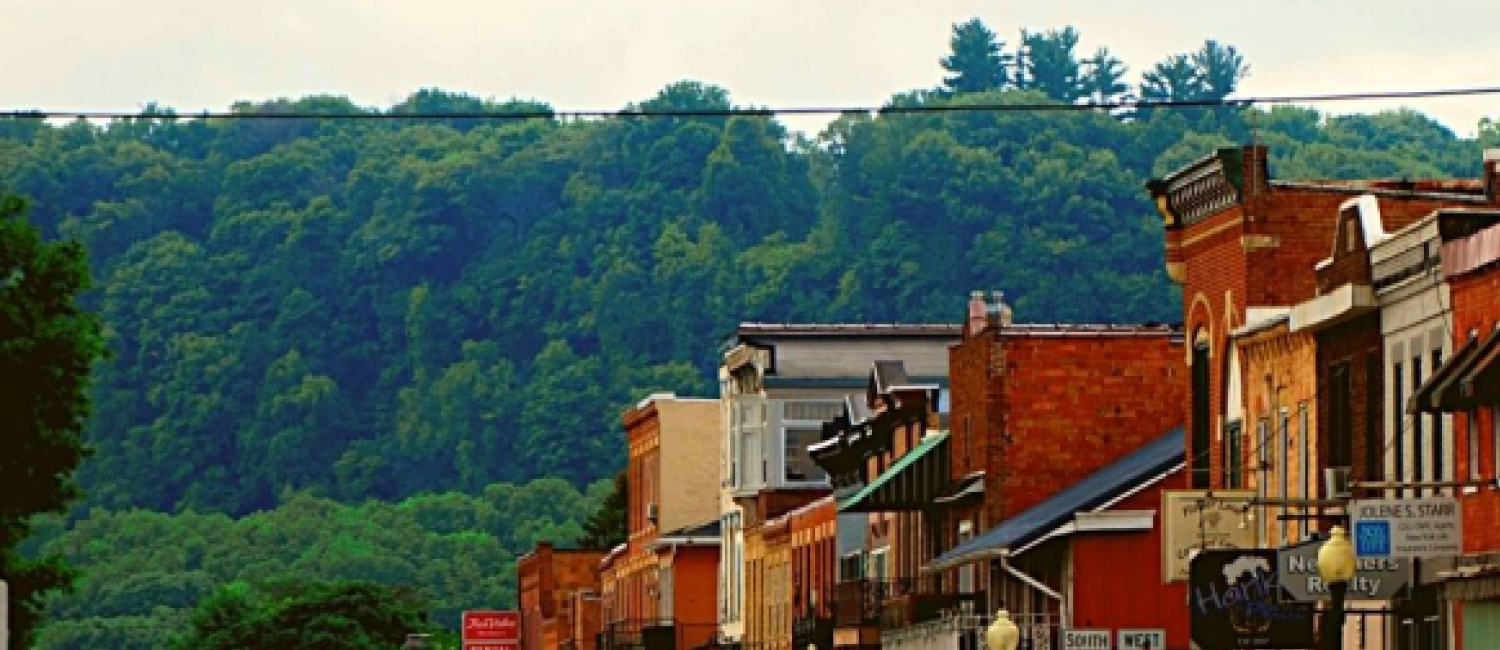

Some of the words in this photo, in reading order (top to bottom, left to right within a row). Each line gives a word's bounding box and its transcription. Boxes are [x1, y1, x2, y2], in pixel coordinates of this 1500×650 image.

[1289, 555, 1399, 570] Neers
[1307, 576, 1381, 596] Rlty
[1067, 633, 1107, 647] SOUTH
